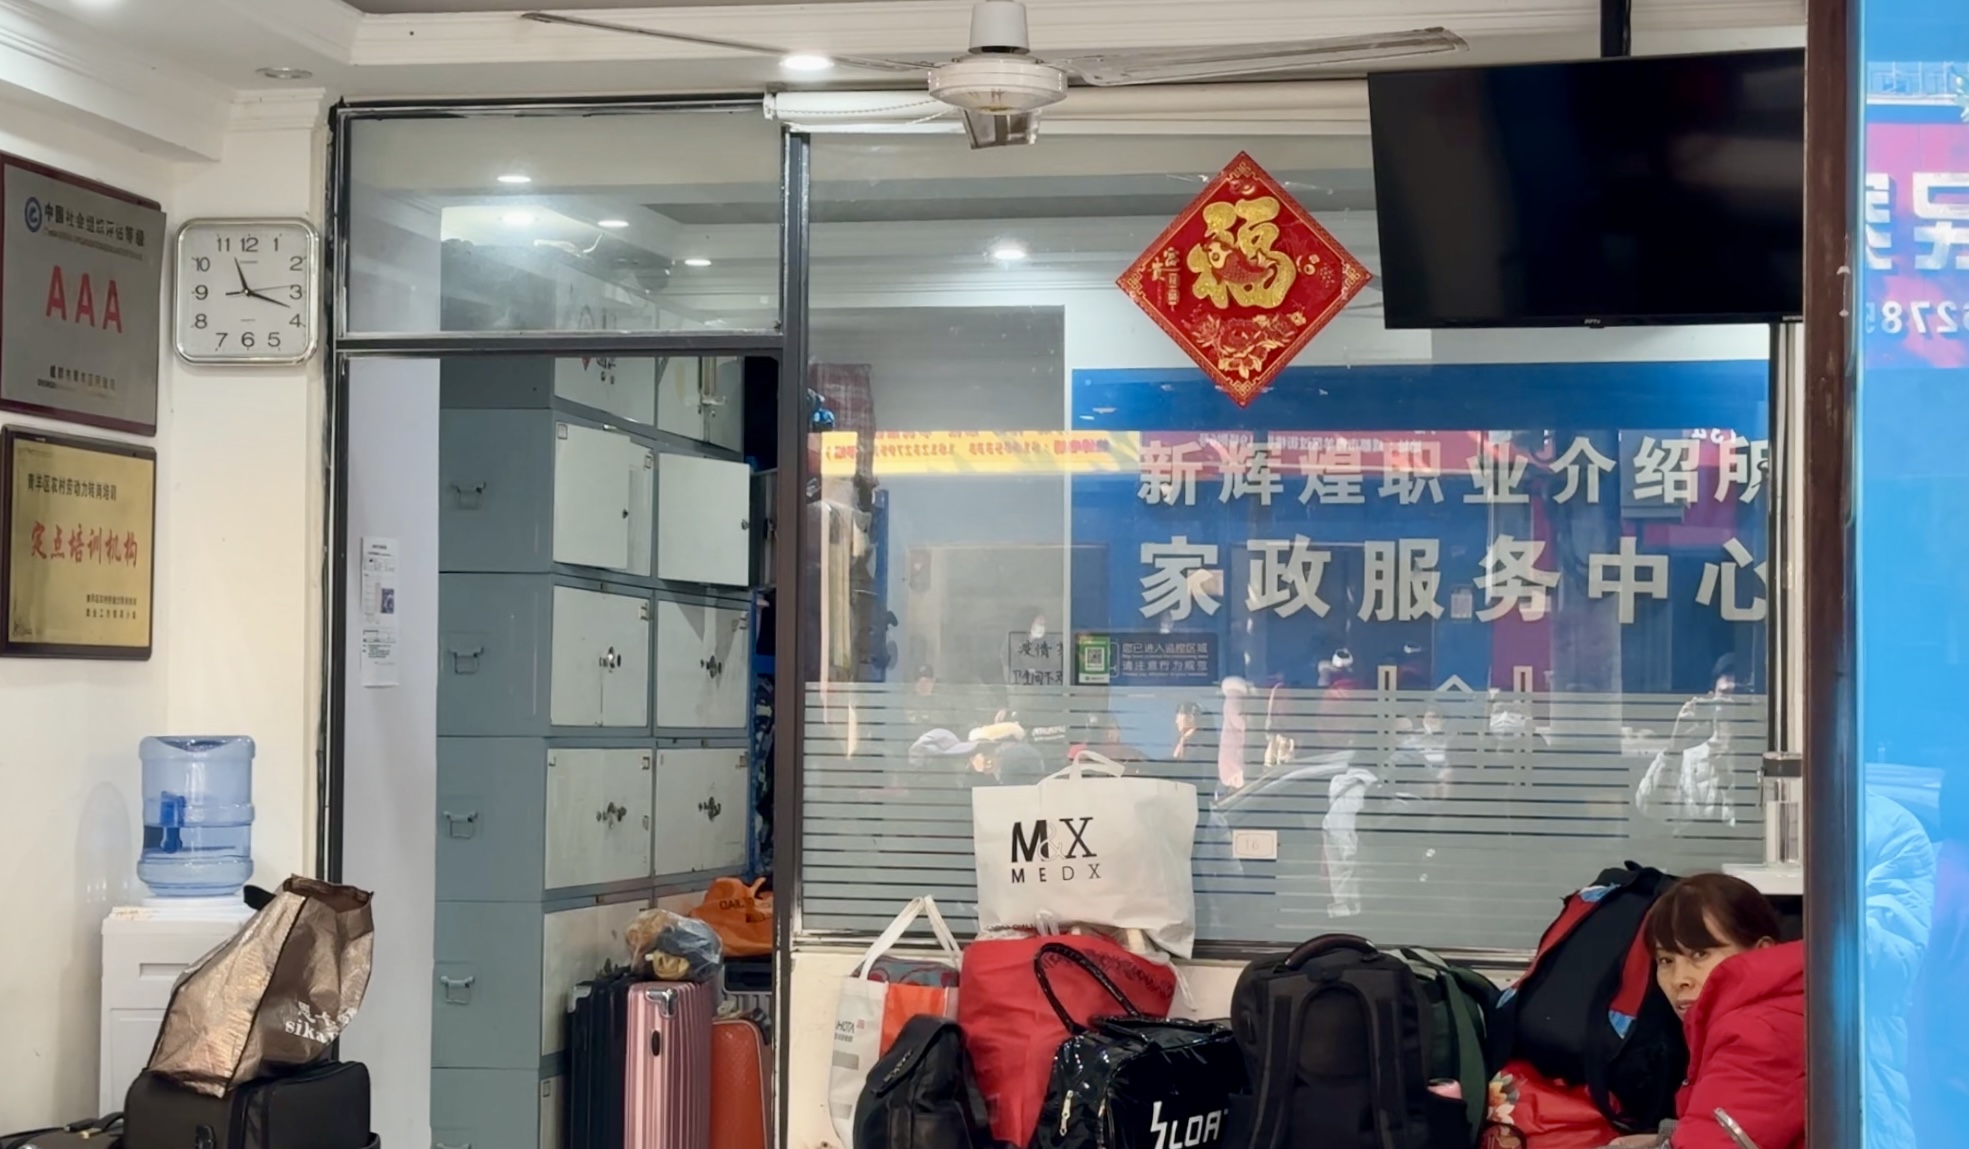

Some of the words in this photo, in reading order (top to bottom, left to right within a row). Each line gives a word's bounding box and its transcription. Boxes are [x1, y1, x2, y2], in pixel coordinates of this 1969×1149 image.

[217, 237, 230, 252] 11
[240, 237, 259, 252] 12
[194, 256, 211, 272] 10
[289, 255, 303, 271] 2
[46, 265, 122, 334] AAA
[194, 284, 209, 300] 9
[289, 284, 303, 300] 3
[194, 313, 208, 330] 8
[288, 313, 302, 328] 4
[215, 332, 229, 348] 7
[241, 331, 256, 348] 6
[267, 331, 281, 348] 5
[1137, 436, 1769, 505] 新辉煌职业介绍所
[31, 520, 138, 568] 定点培训机构
[1138, 533, 1767, 623] 家政服务中心
